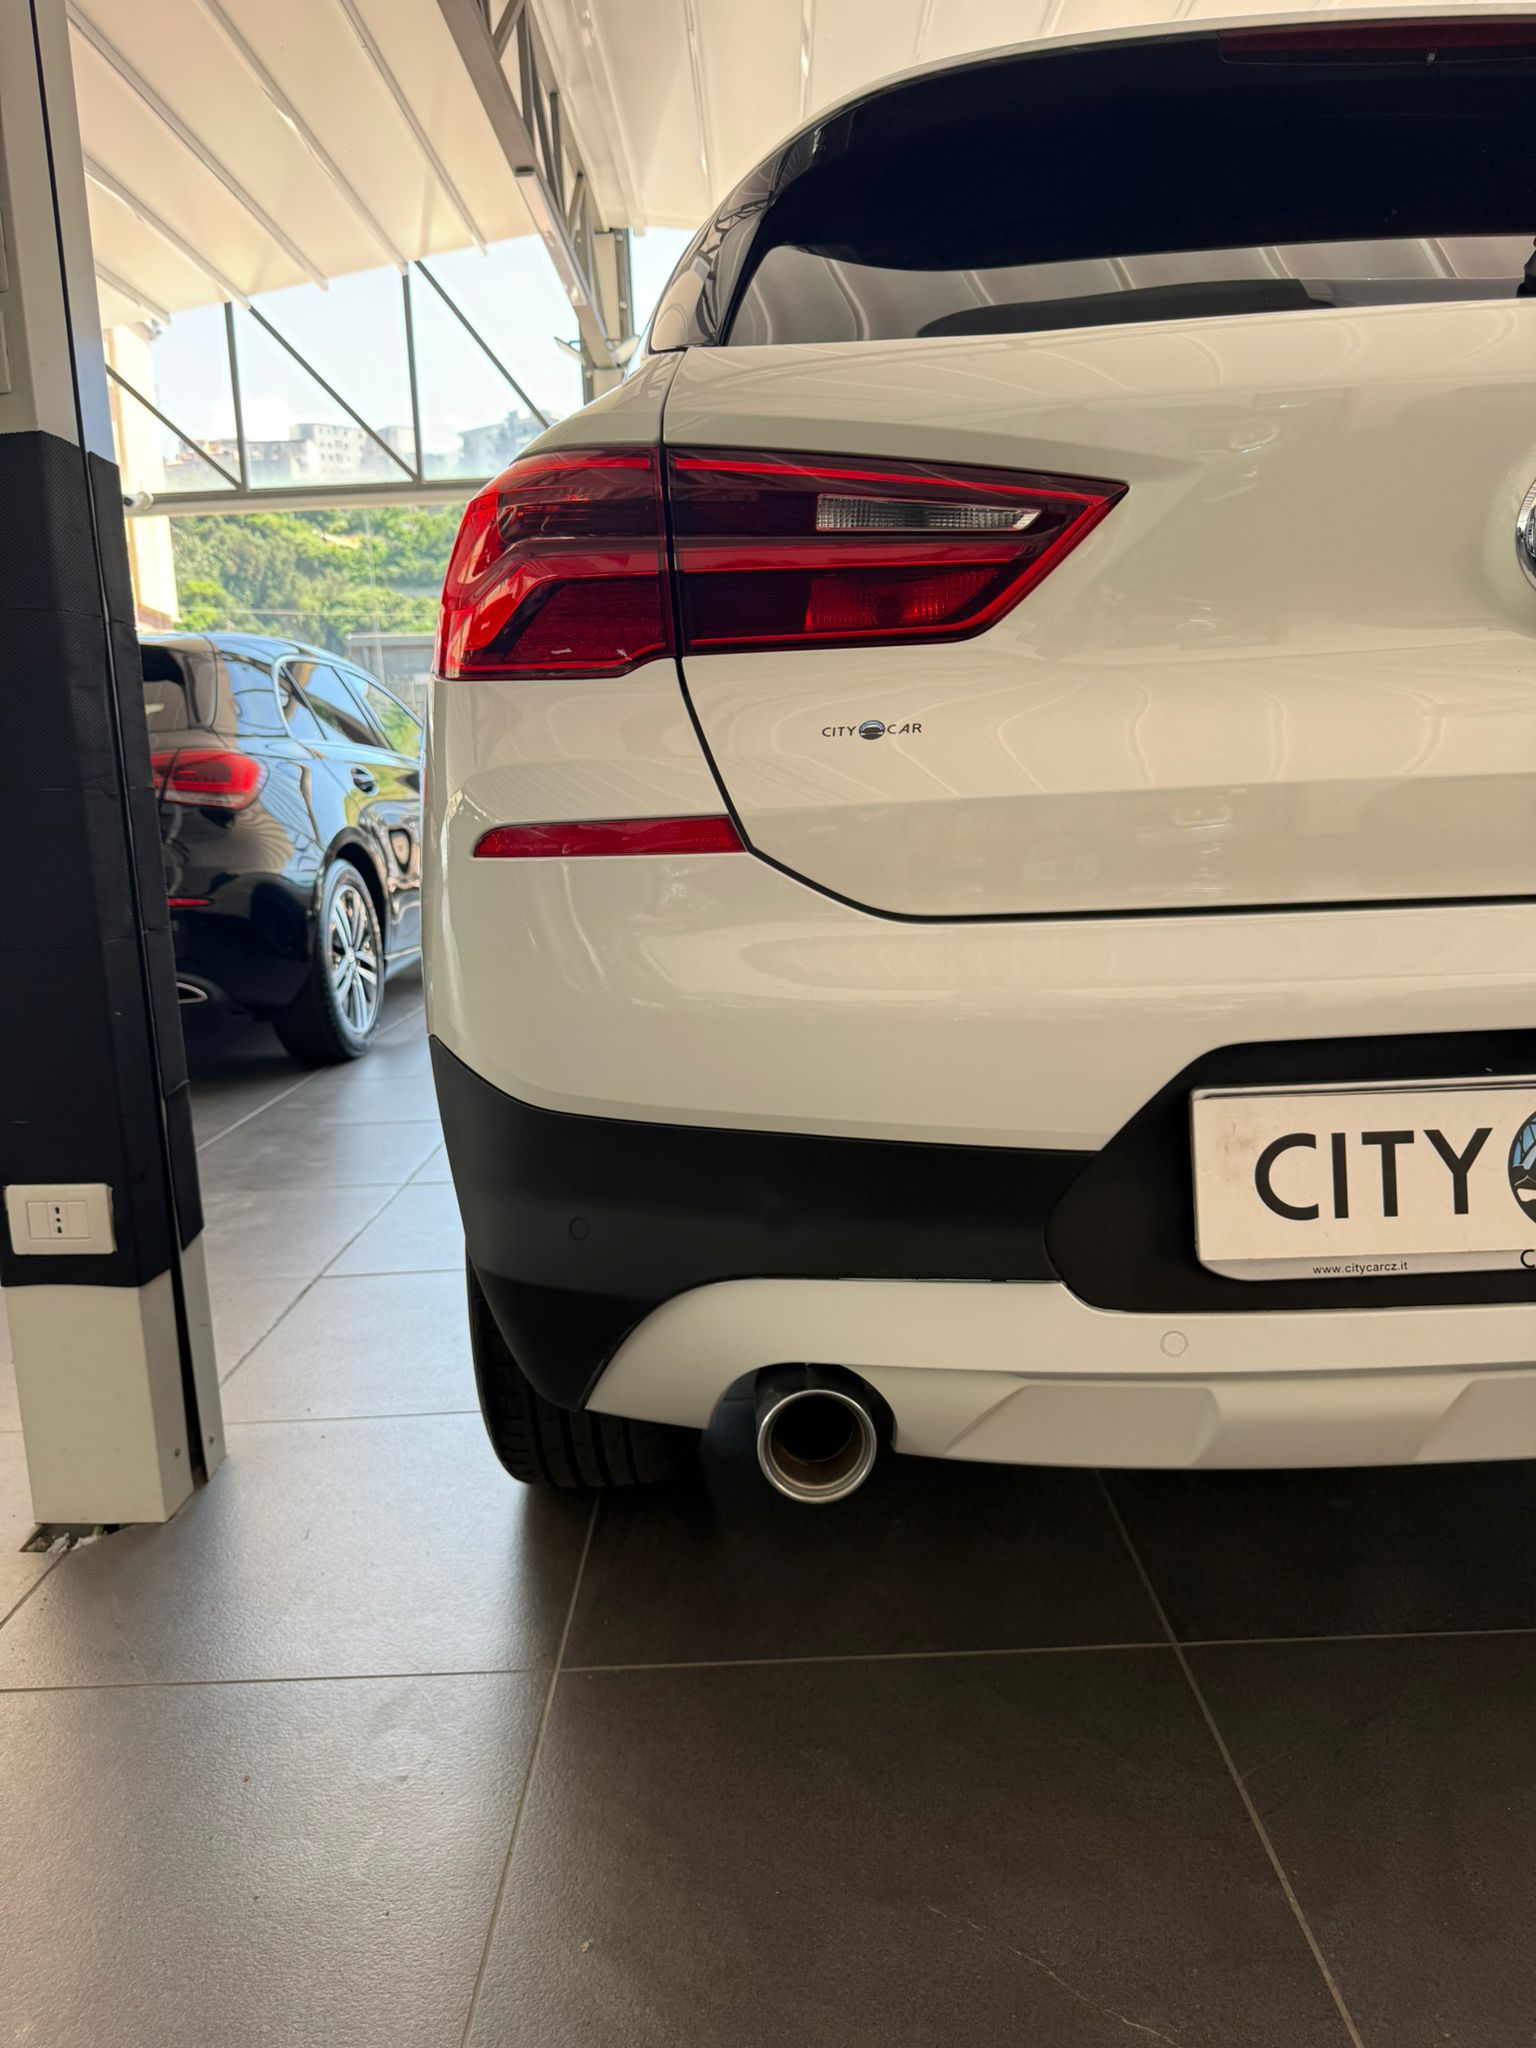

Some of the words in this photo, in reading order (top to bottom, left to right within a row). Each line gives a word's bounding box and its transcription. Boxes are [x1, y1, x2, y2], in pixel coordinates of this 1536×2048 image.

[822, 726, 856, 737] CITY
[887, 723, 922, 734] CAR
[1254, 1127, 1493, 1221] CITY
[1312, 1260, 1408, 1274] www.citycarcz.it
